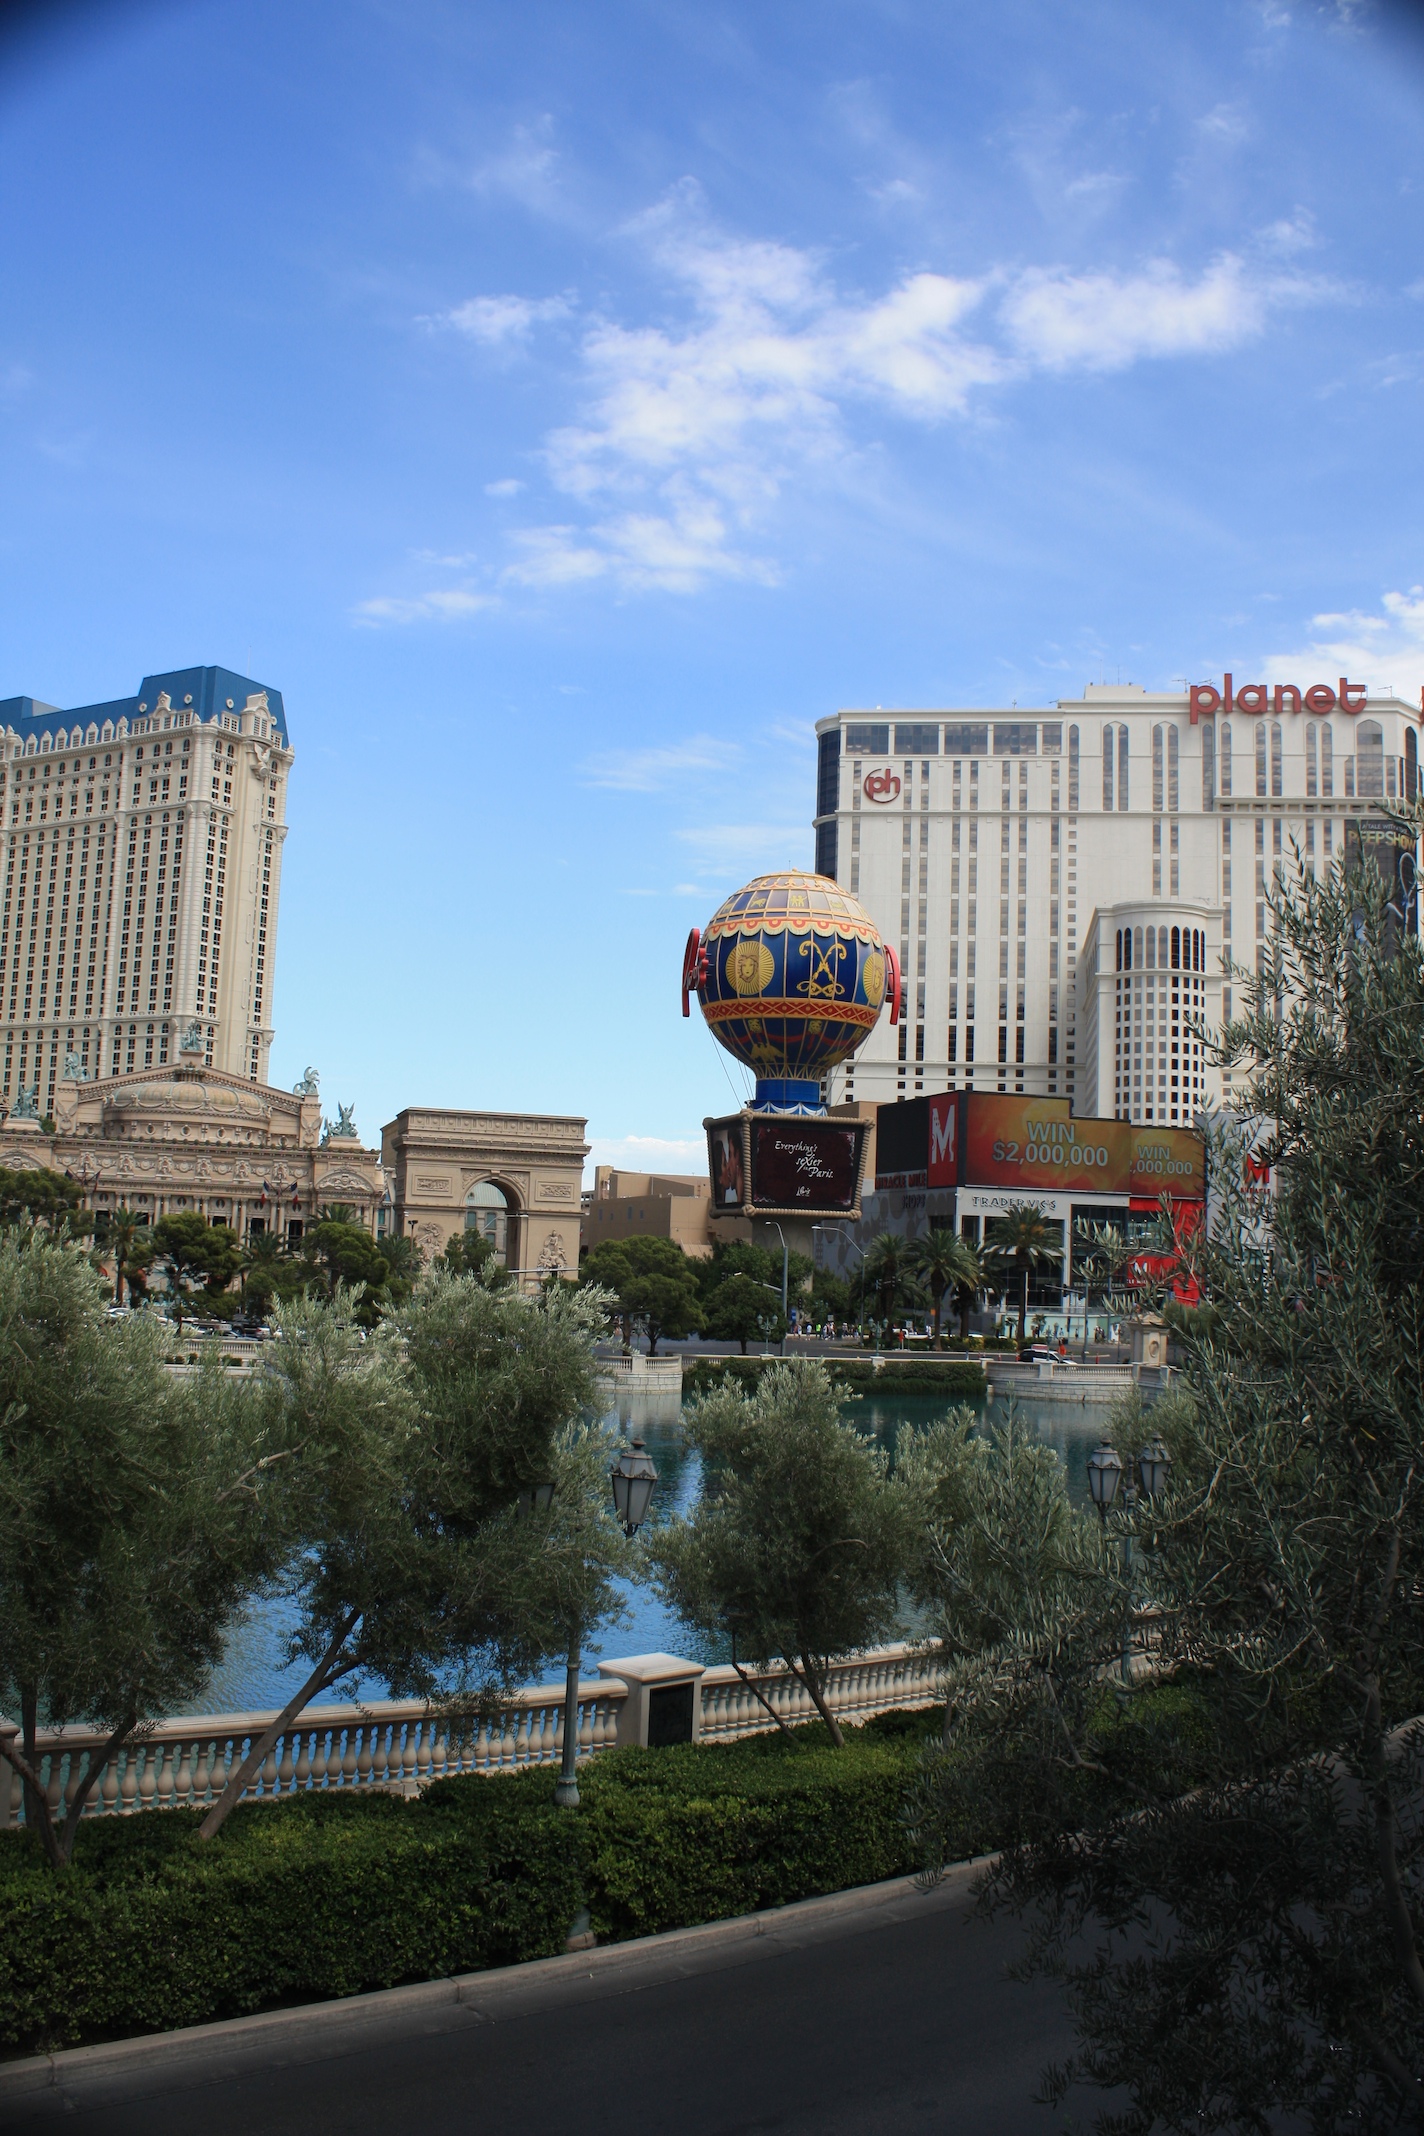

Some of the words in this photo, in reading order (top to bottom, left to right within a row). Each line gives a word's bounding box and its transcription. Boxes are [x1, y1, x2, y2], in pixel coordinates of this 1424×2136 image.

[1190, 673, 1367, 725] planet
[867, 769, 901, 801] ph
[931, 1104, 955, 1164] M
[1027, 1121, 1075, 1144] WIN
[992, 1139, 1109, 1168] $2,000,000
[1137, 1145, 1170, 1160] WIN
[973, 1196, 1025, 1208] TRADER
